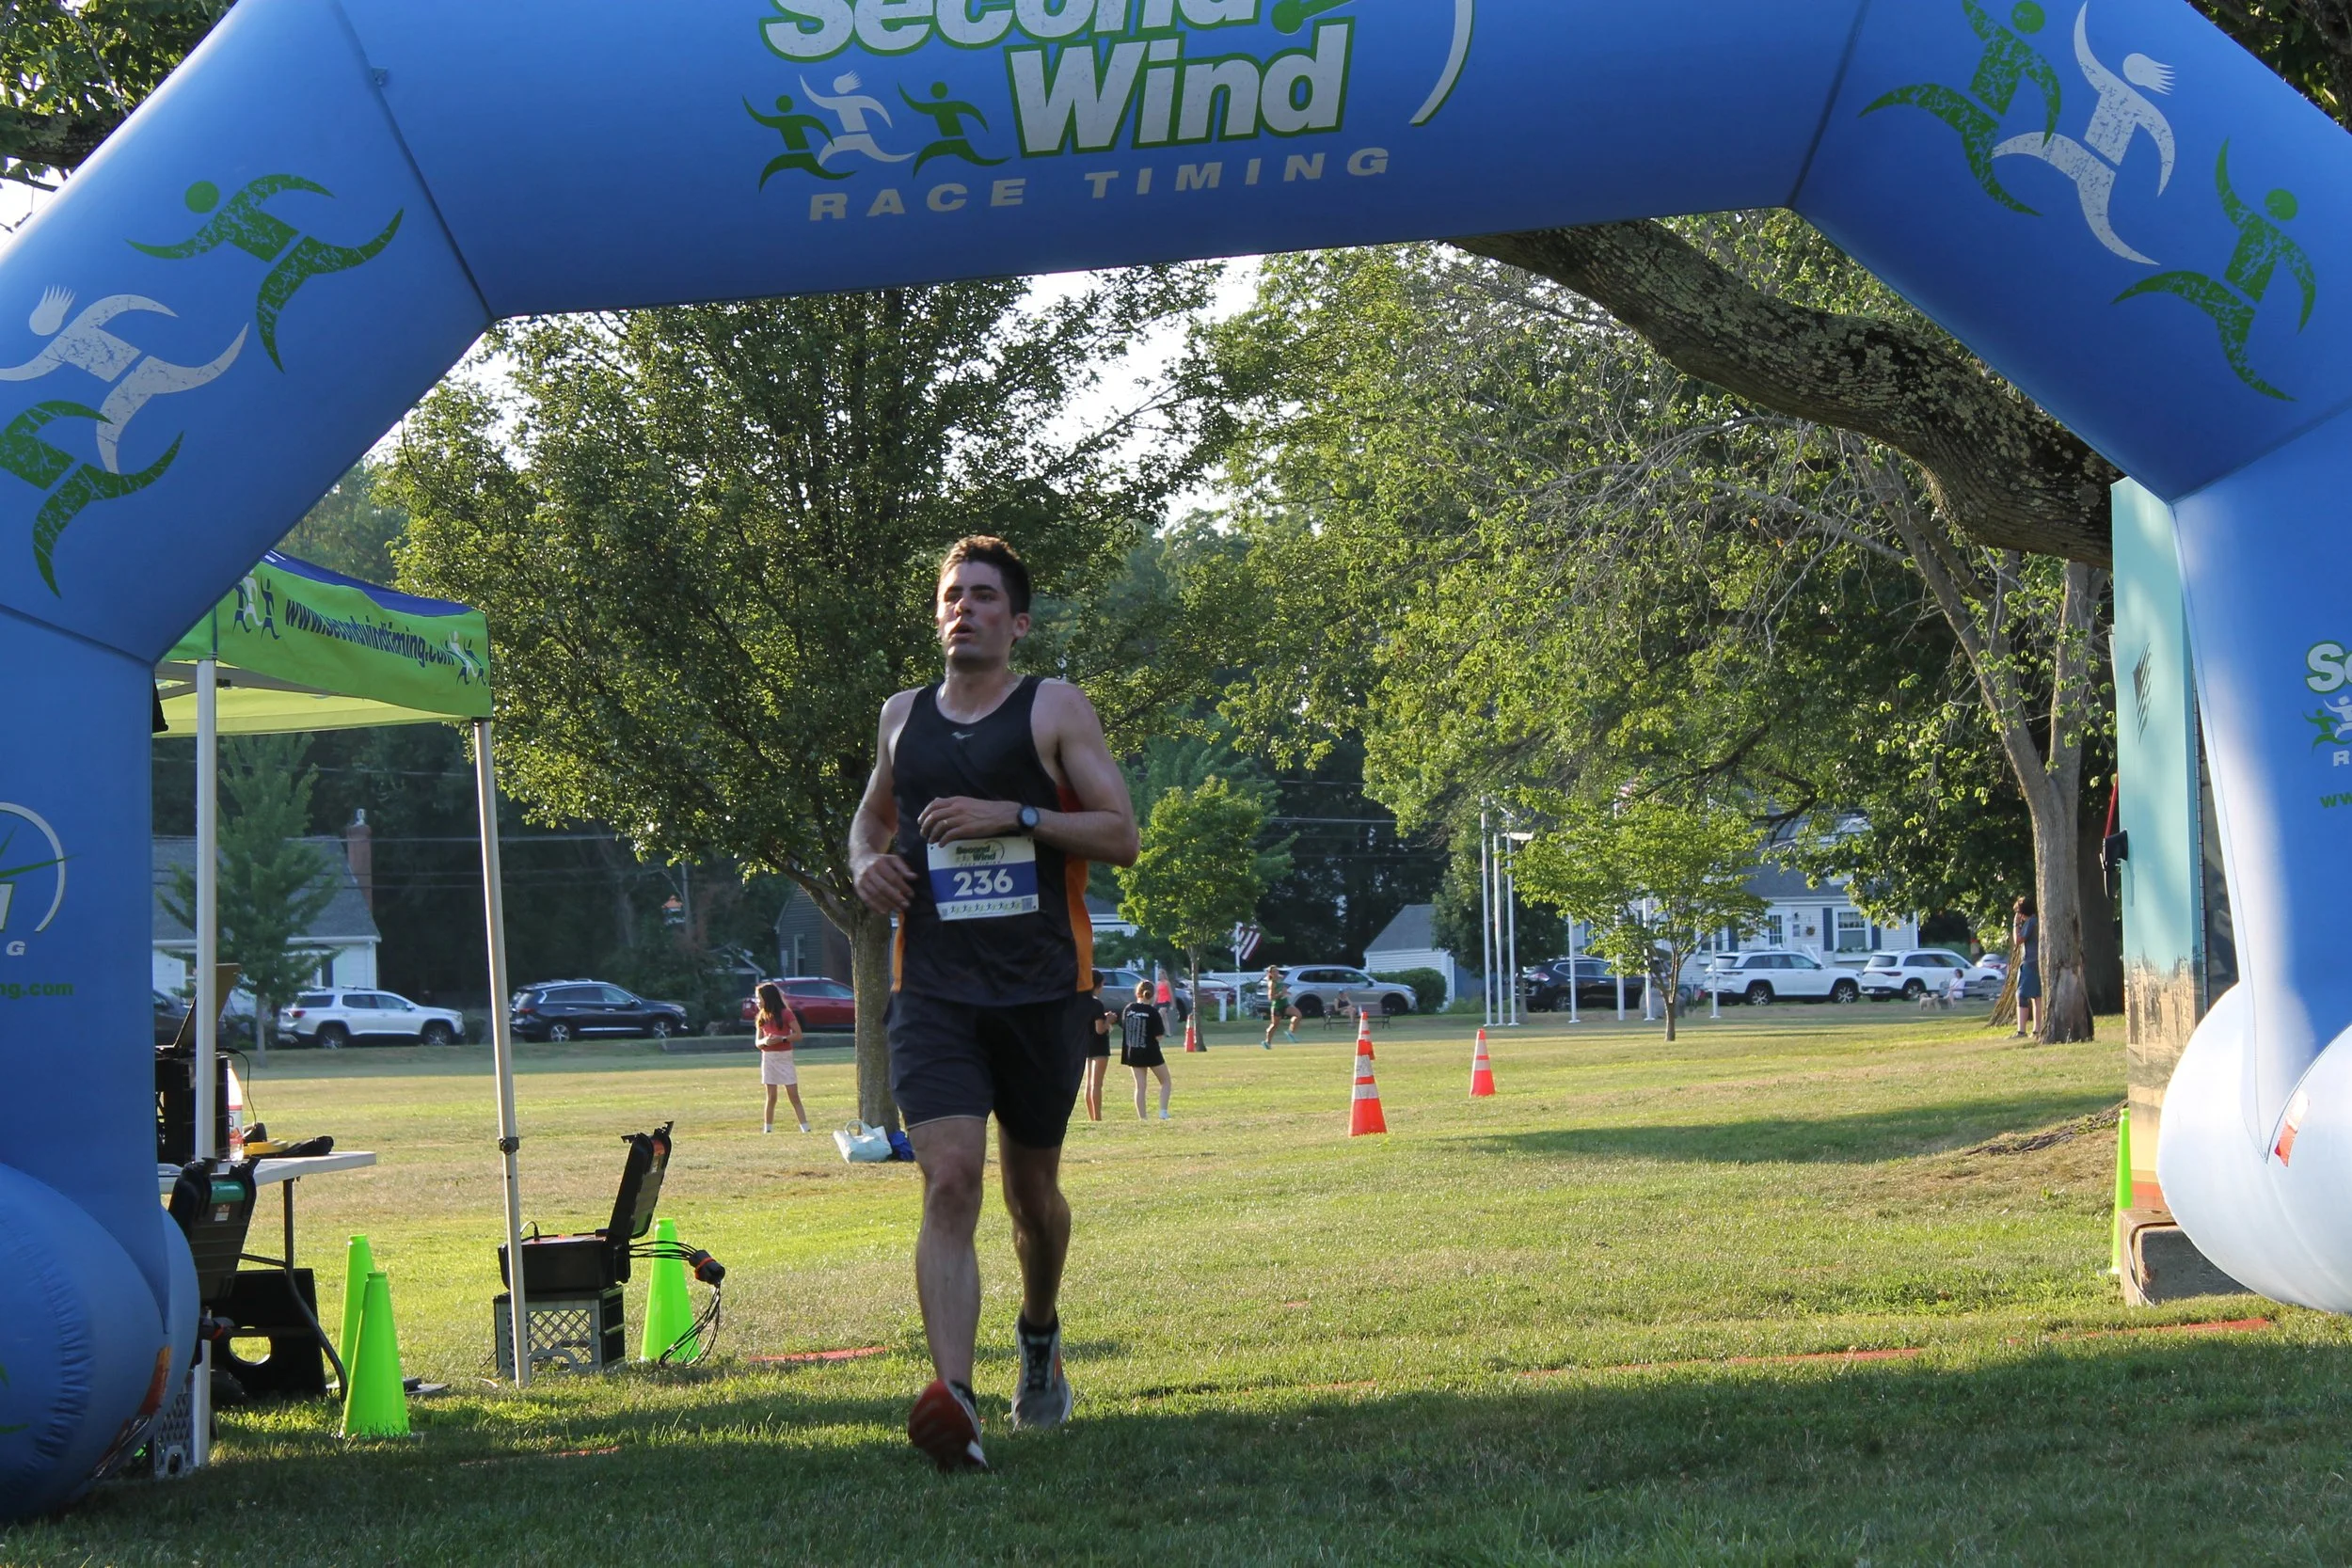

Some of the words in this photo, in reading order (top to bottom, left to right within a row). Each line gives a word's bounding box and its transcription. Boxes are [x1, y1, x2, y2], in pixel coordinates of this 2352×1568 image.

[759, 0, 1261, 63] Sec
[1004, 16, 1356, 158] Wind
[808, 178, 1027, 222] RACE
[1085, 147, 1391, 200] TIMING
[2305, 640, 2352, 694] S
[953, 868, 1013, 896] 236
[972, 850, 996, 862] Wind
